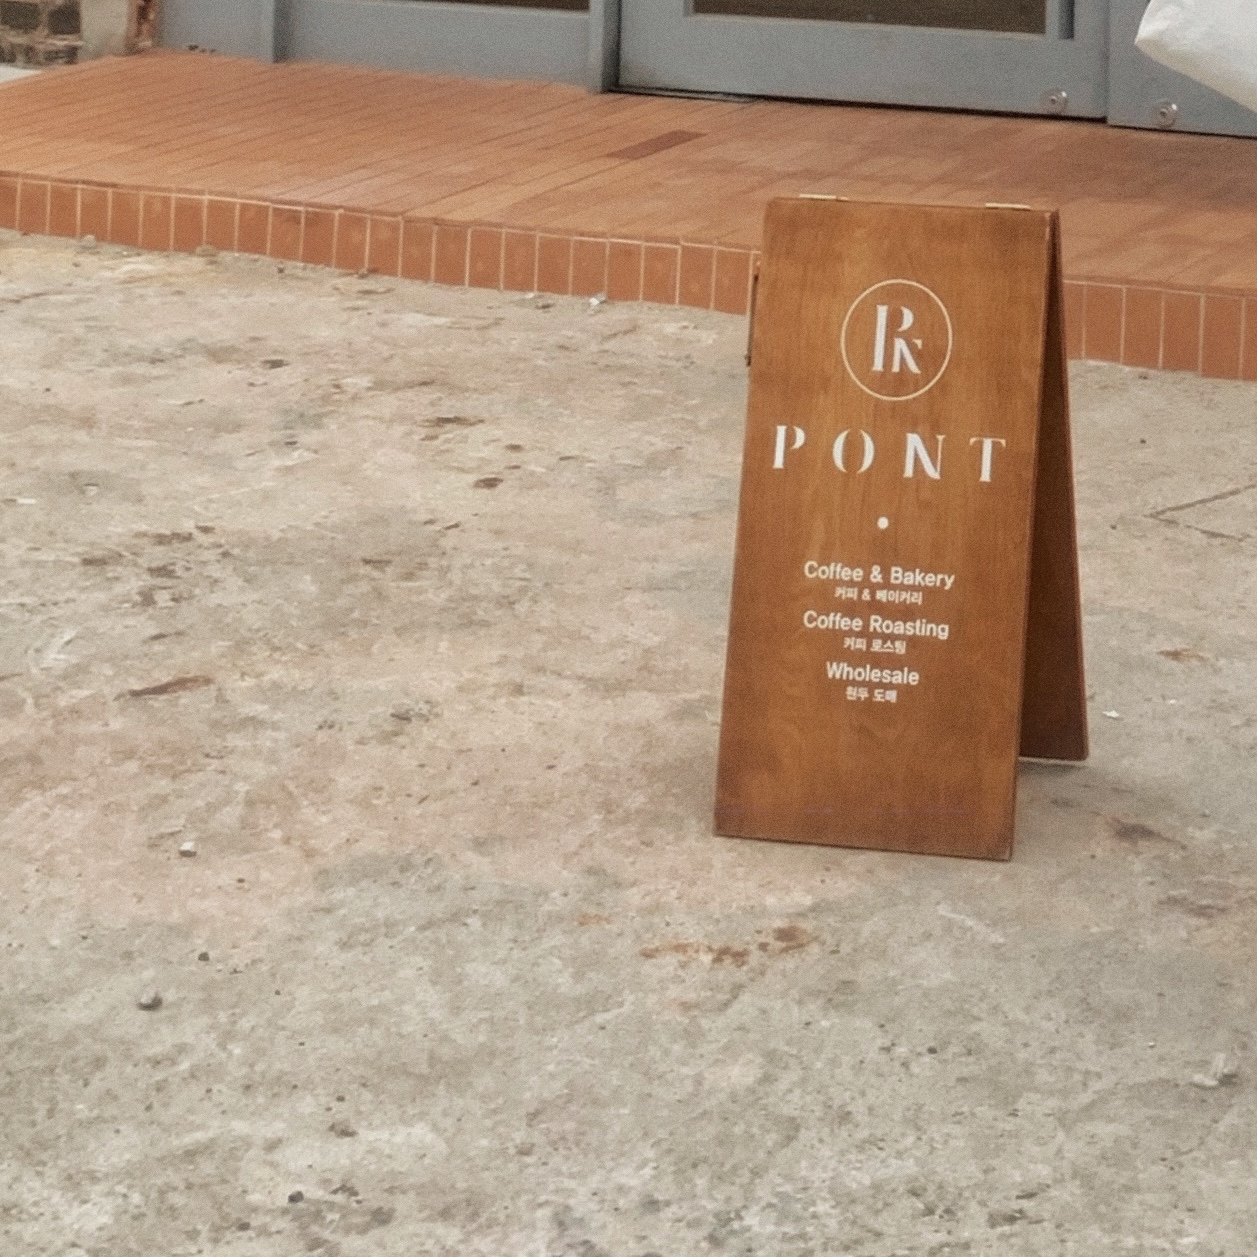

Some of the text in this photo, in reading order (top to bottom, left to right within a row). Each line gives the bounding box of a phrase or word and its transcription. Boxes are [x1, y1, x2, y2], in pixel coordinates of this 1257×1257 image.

[772, 424, 1007, 483] PONT
[803, 560, 955, 590] Coffee & Bakery
[834, 586, 923, 606] 커피 & 베이커리
[803, 610, 949, 640] Coffee Roasting
[843, 637, 867, 652] 커피
[826, 661, 920, 685] Wholesale
